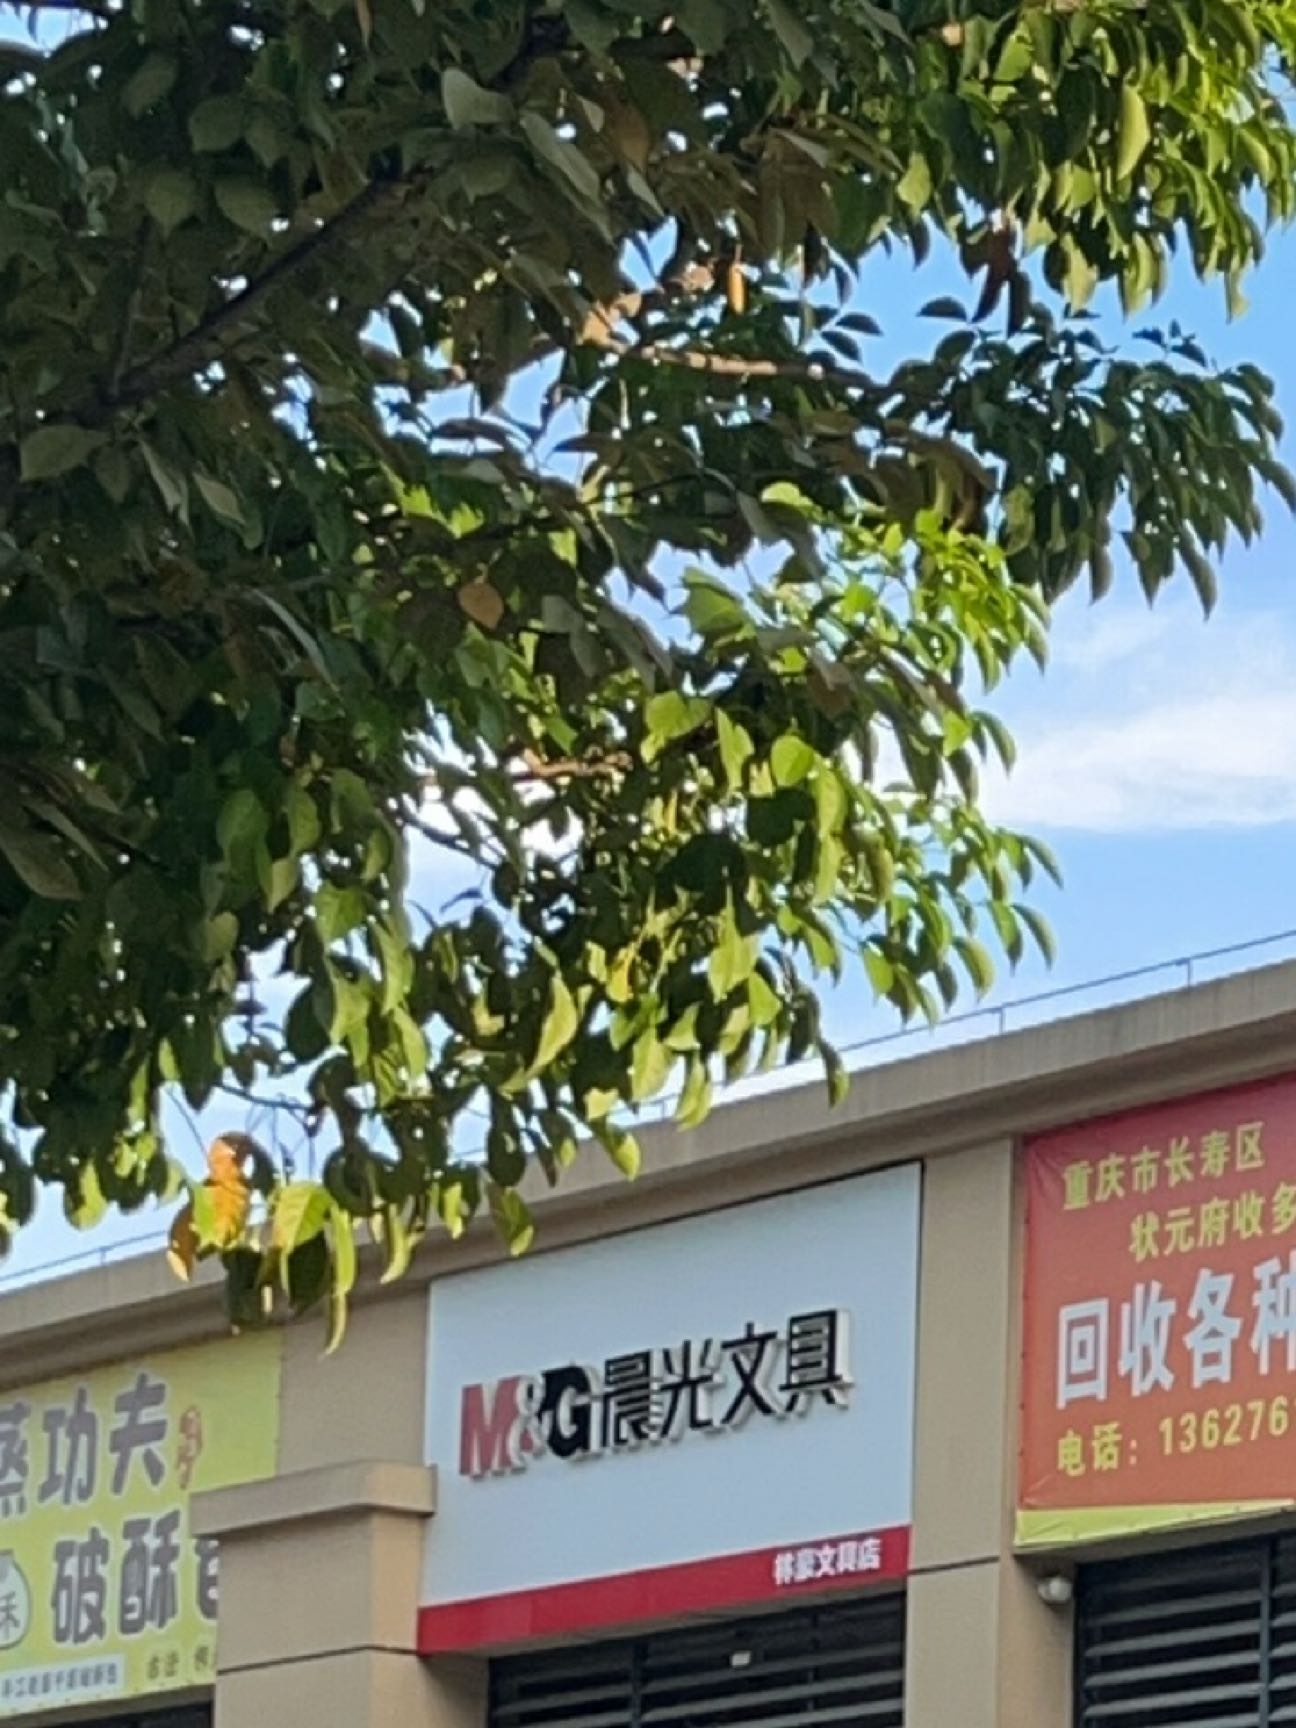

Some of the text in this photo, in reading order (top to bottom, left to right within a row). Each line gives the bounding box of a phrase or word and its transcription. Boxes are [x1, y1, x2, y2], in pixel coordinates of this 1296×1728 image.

[1063, 1121, 1265, 1210] 重庆市长寿区
